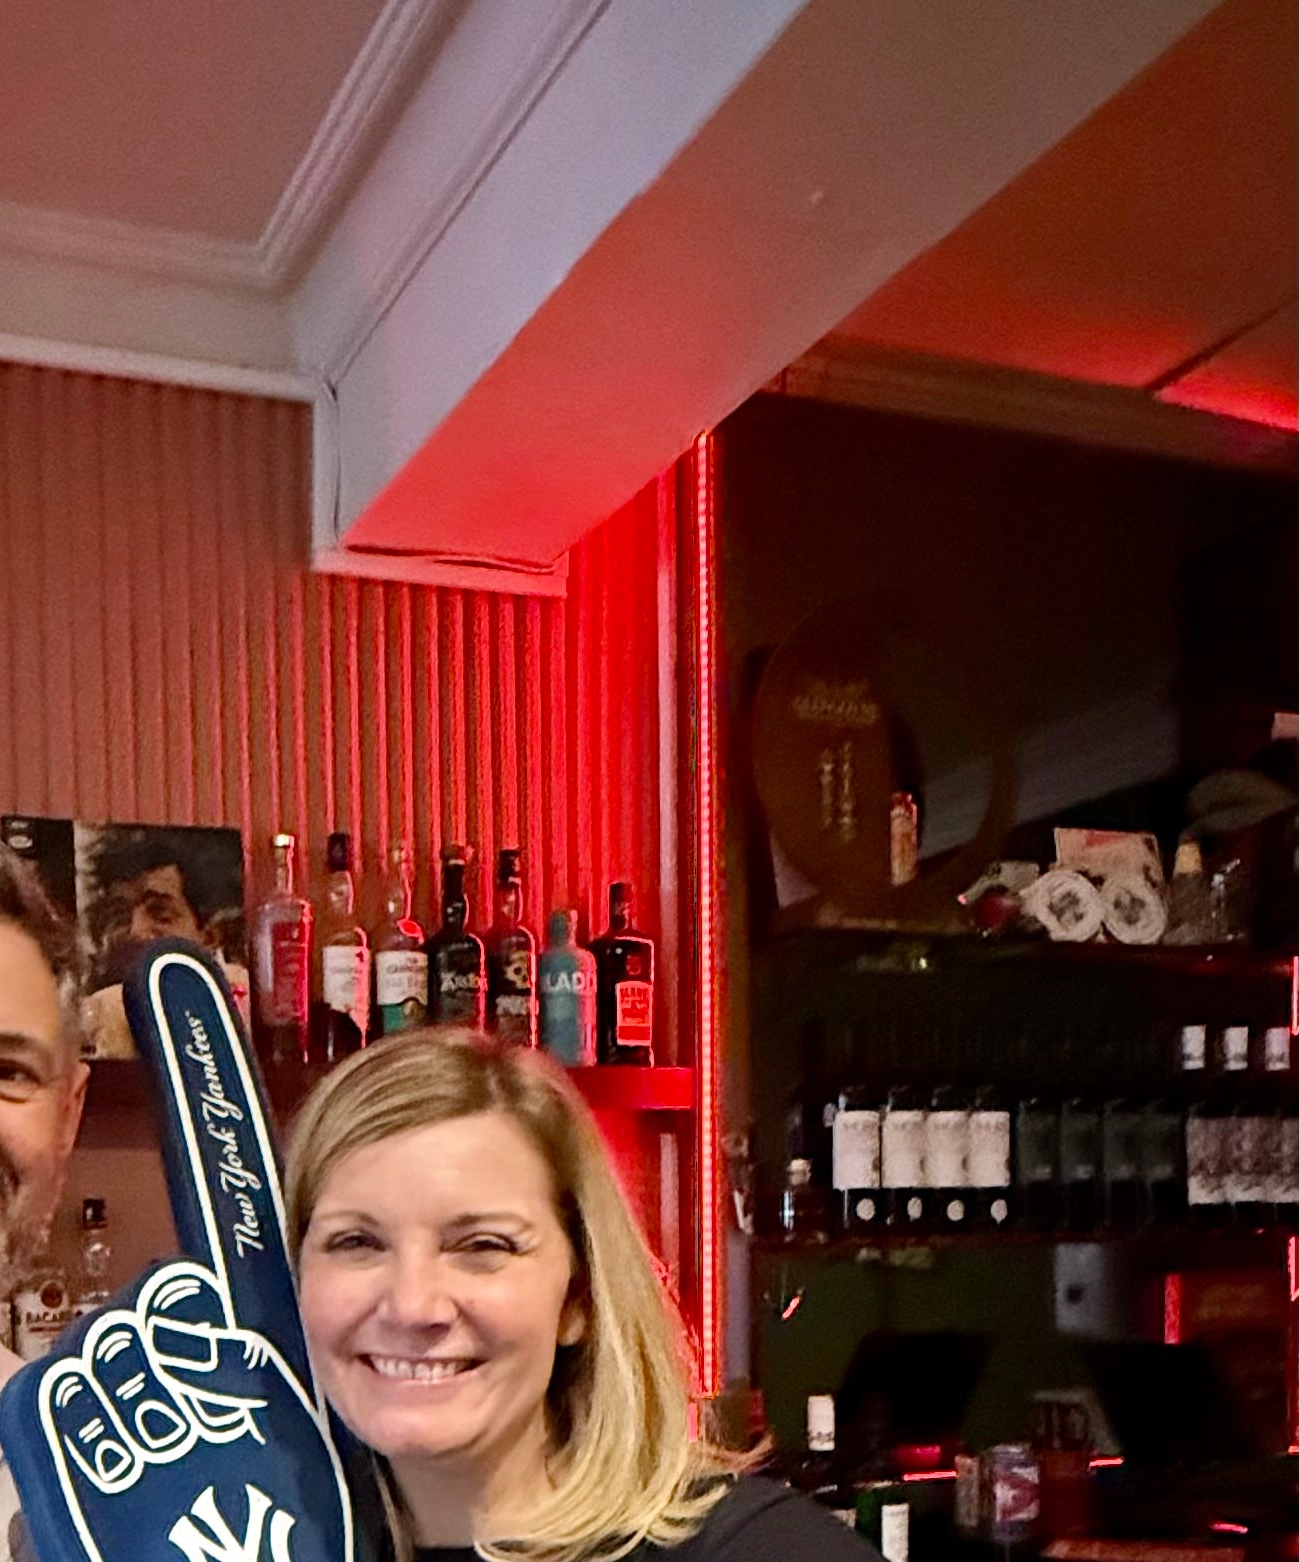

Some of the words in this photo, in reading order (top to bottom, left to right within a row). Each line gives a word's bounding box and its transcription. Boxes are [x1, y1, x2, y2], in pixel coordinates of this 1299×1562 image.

[184, 1010, 244, 1123] Yankees
[207, 1121, 262, 1193] York
[233, 1191, 265, 1259] New
